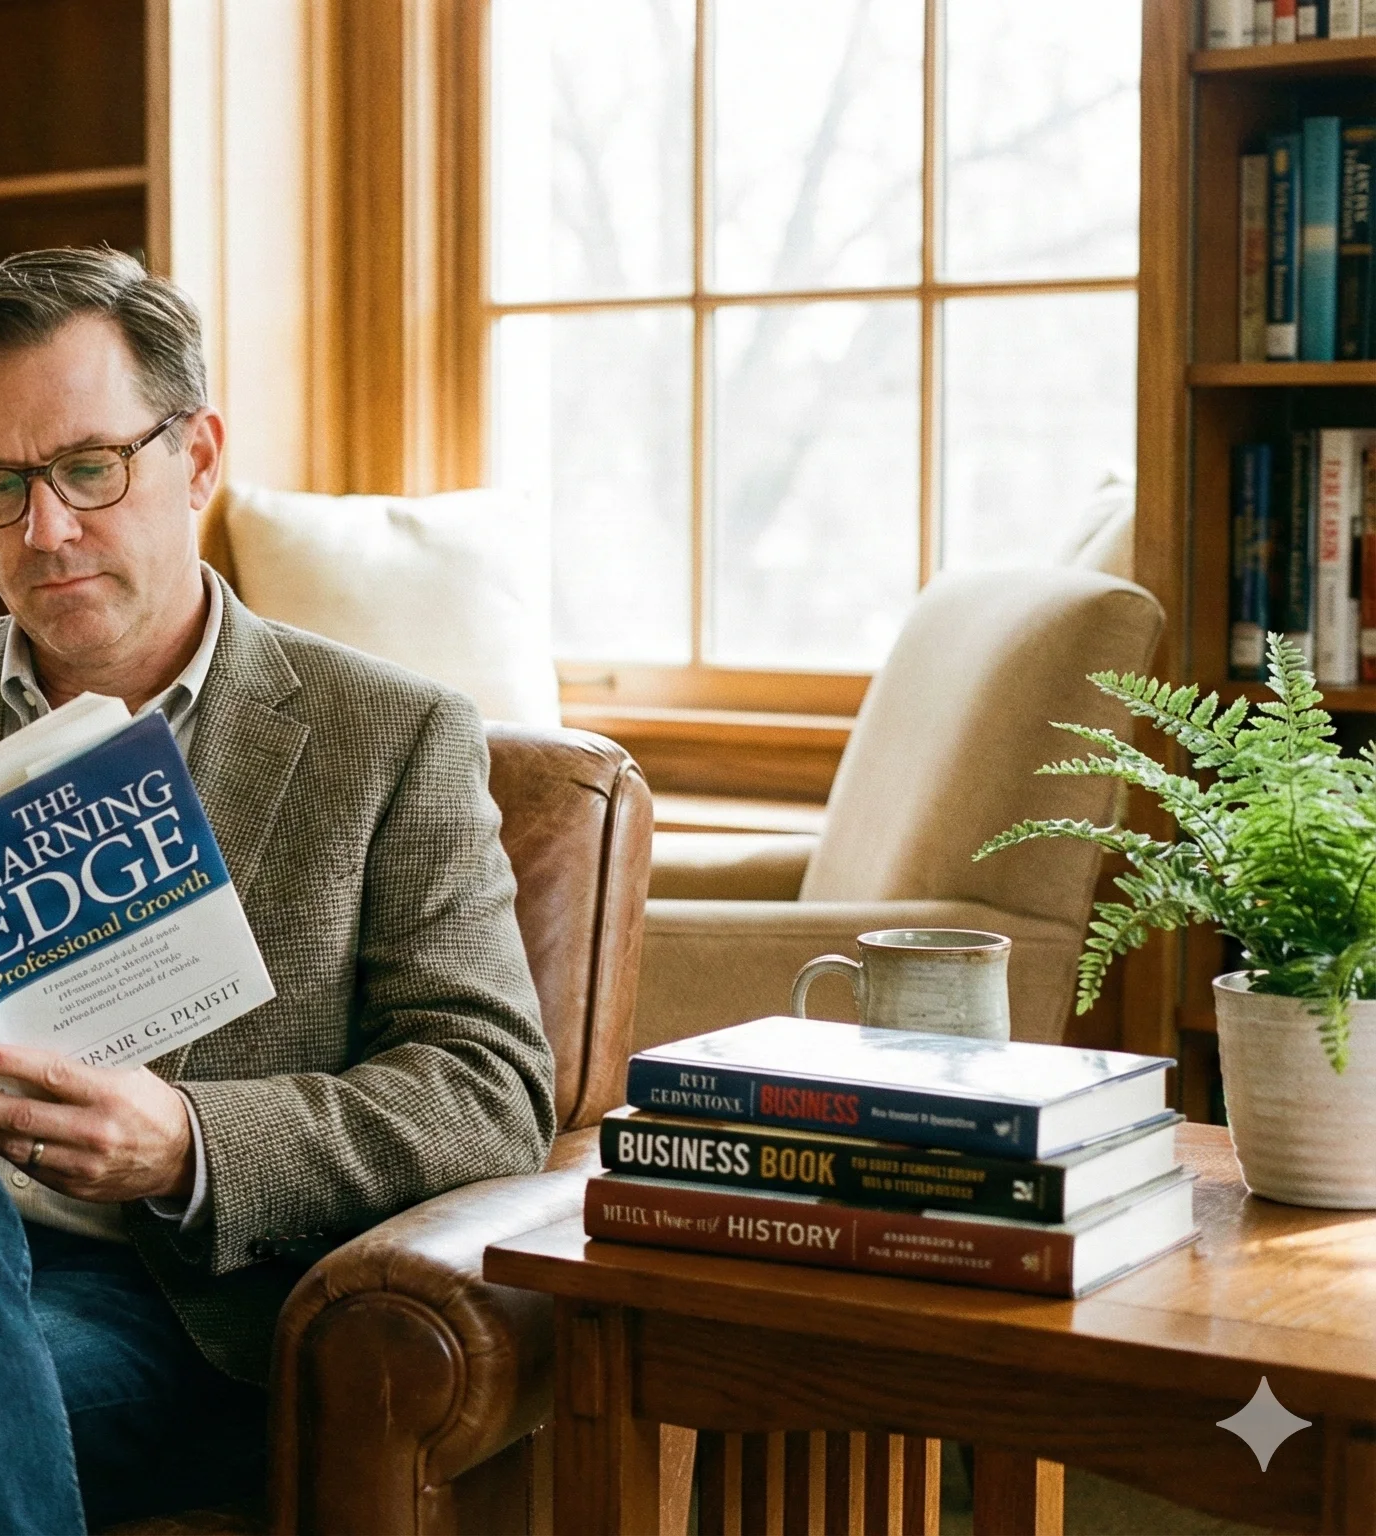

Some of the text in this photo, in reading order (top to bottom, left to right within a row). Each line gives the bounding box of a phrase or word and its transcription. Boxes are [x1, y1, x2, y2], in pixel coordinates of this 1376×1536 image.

[12, 782, 81, 831] THE
[126, 868, 210, 924] Growth
[144, 1021, 166, 1038] G.
[759, 1084, 860, 1126] BUSINESS
[618, 1131, 751, 1176] BUSINESS
[760, 1146, 836, 1186] BOOK
[728, 1215, 841, 1250] HISTORY
